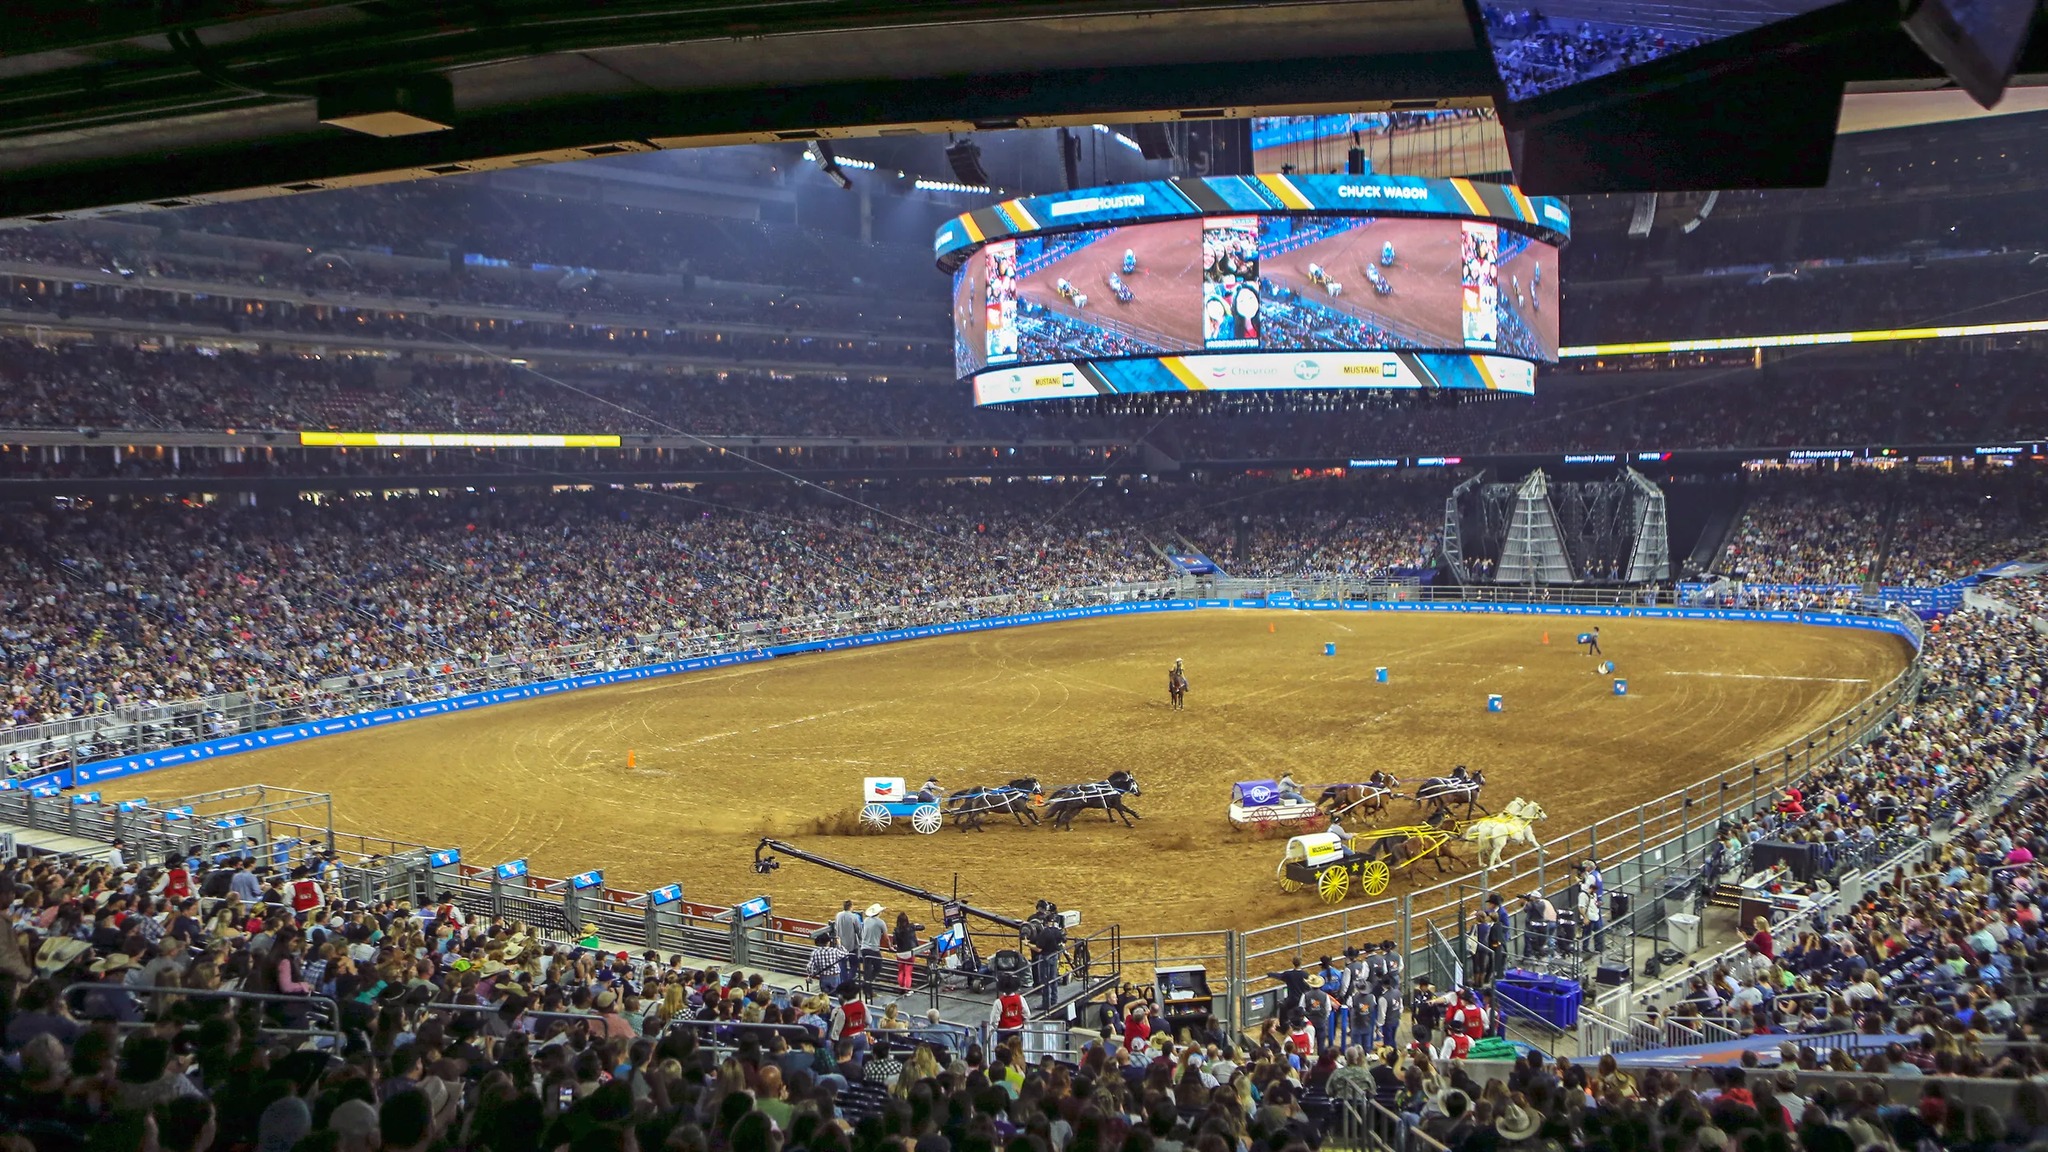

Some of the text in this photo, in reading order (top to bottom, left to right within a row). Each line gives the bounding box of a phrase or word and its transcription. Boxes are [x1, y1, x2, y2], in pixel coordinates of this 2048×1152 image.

[1338, 185, 1428, 200] CHUCK WAGON
[1231, 367, 1278, 376] Chevron
[1343, 366, 1379, 374] MUSTANG
[1035, 377, 1060, 386] MUSTANG
[607, 892, 614, 901] 4
[687, 906, 693, 915] 3
[776, 921, 783, 931] 2
